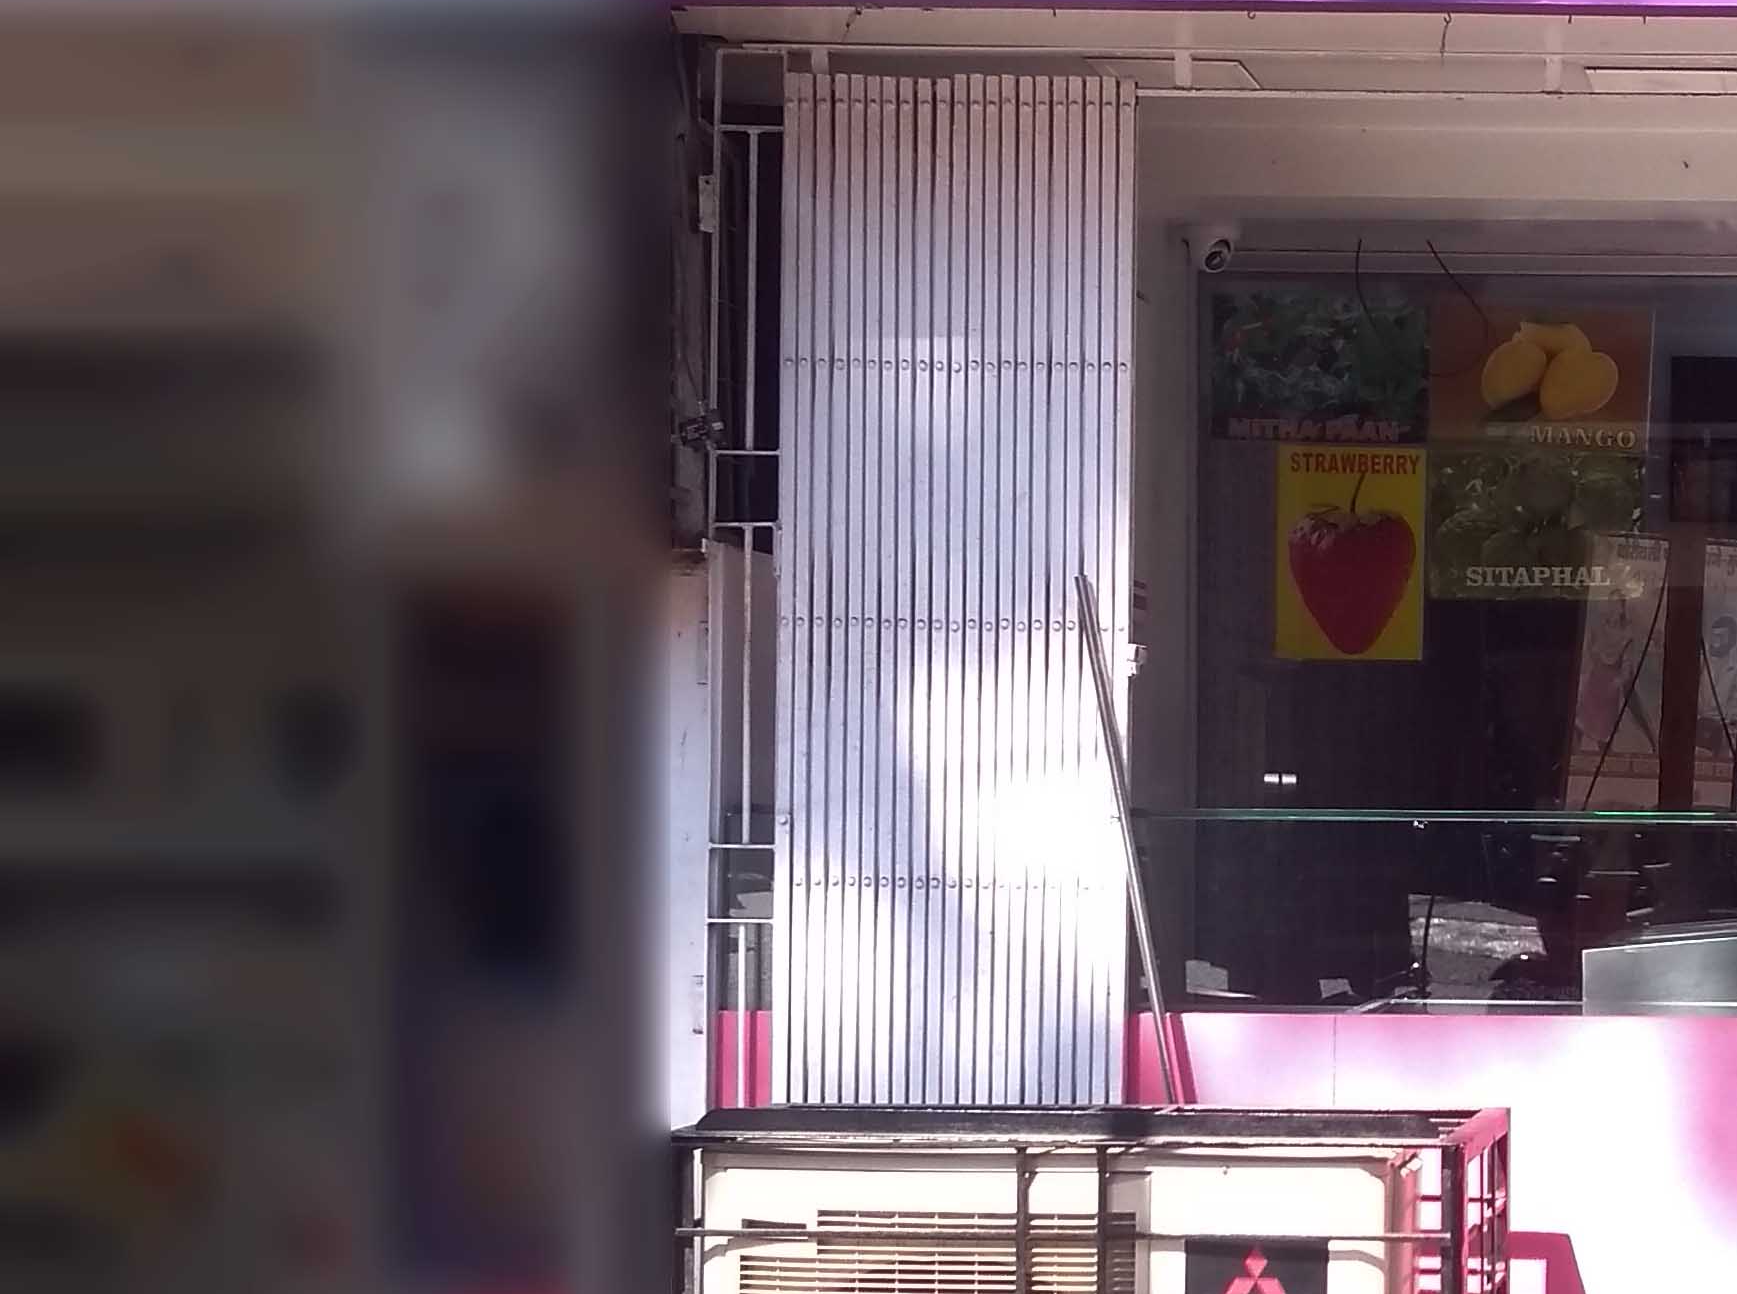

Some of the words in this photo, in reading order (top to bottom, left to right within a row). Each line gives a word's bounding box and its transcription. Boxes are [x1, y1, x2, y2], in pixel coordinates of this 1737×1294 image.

[1531, 425, 1636, 448] MANGO
[1290, 452, 1420, 475] STRAWBERRY
[1466, 566, 1610, 587] SITAPHAL
